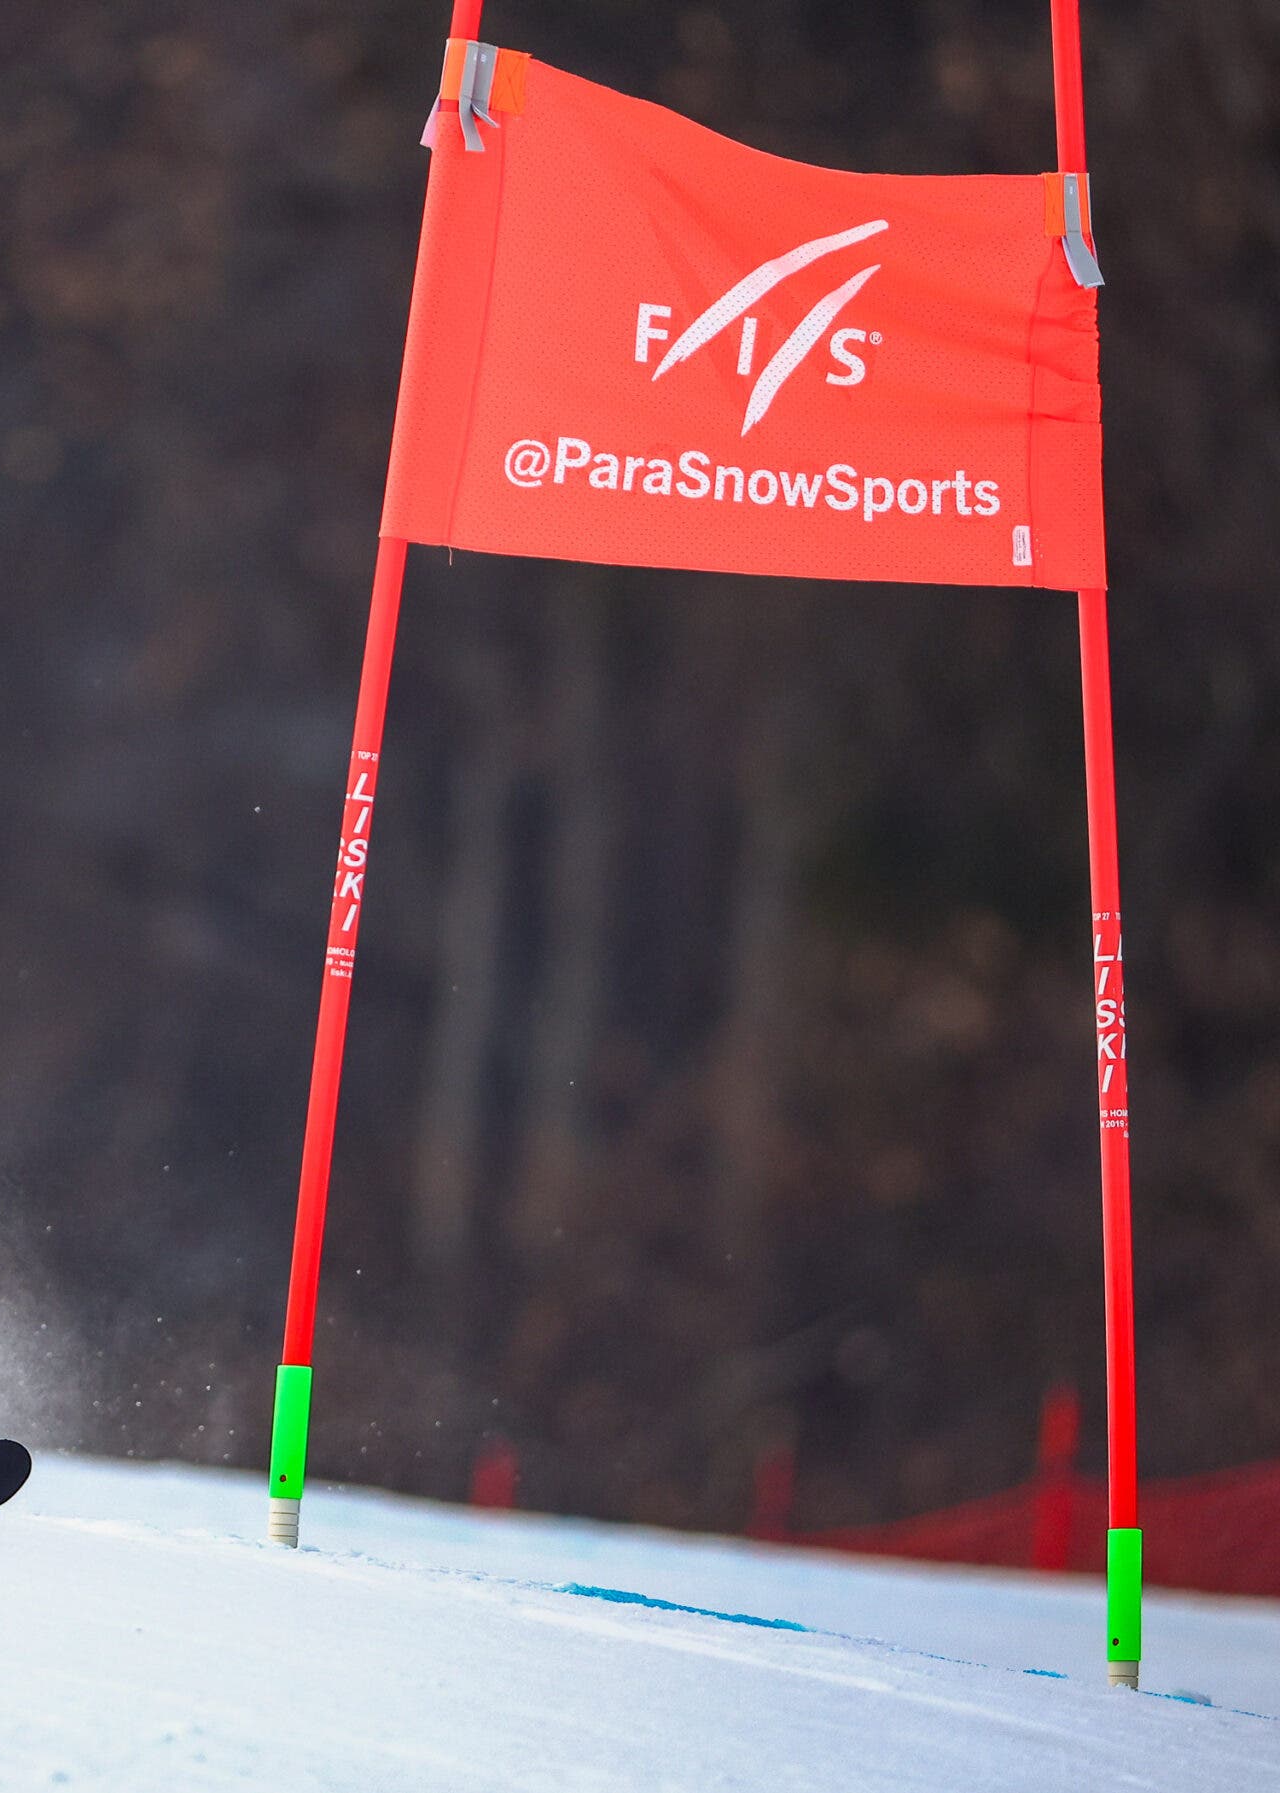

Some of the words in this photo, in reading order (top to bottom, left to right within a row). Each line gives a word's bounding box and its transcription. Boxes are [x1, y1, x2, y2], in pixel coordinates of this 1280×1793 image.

[503, 436, 1001, 522] @ParaSnowSports
[341, 773, 374, 931] LISKI
[1094, 933, 1117, 1093] LISKI
